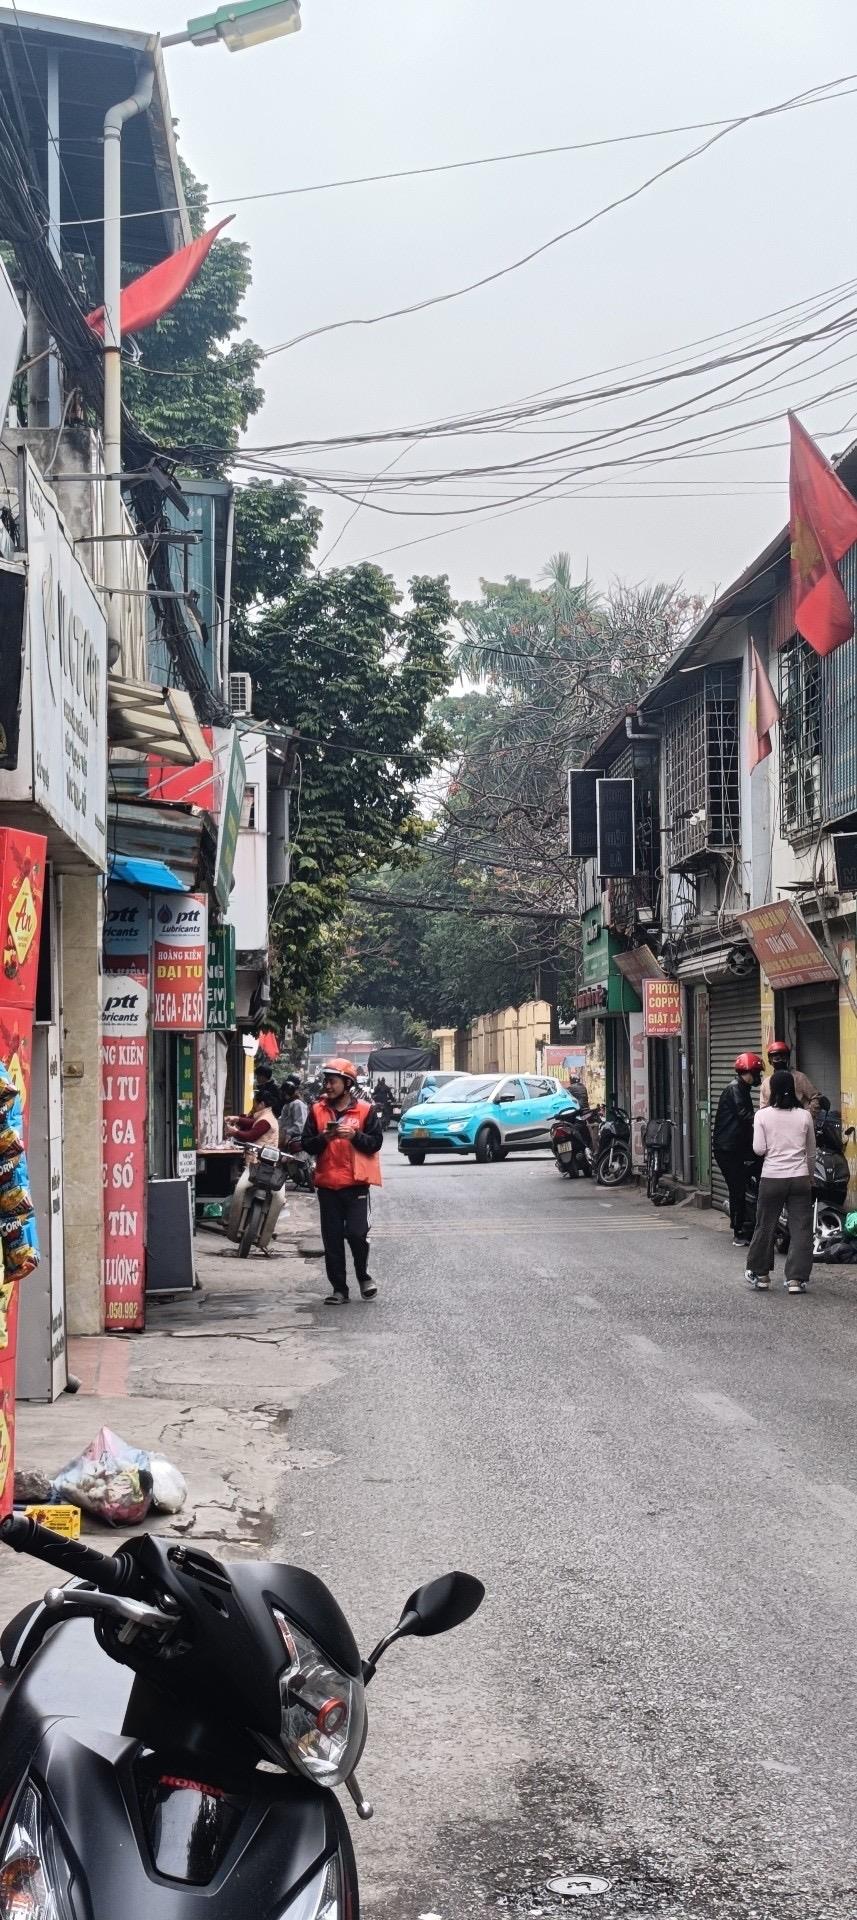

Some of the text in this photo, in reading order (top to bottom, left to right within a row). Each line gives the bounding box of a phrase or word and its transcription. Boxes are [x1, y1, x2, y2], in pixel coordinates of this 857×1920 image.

[161, 924, 201, 933] Lubricants
[175, 909, 201, 925] ptt
[157, 965, 182, 981] ĐẠI
[185, 965, 203, 979] TU
[648, 983, 680, 995] PHOTO
[104, 994, 139, 1012] ptt
[154, 992, 165, 1023] XE
[166, 992, 177, 1023] GA
[182, 992, 192, 1023] XE
[648, 997, 680, 1008] COPPY
[118, 1040, 145, 1066] KIÊN
[117, 1076, 141, 1101] TU
[111, 1119, 137, 1145] GA
[112, 1151, 134, 1190] SỐ
[1, 1216, 23, 1238] CORN
[108, 1204, 138, 1237] TÍN
[105, 1253, 140, 1294] LƯỢNG
